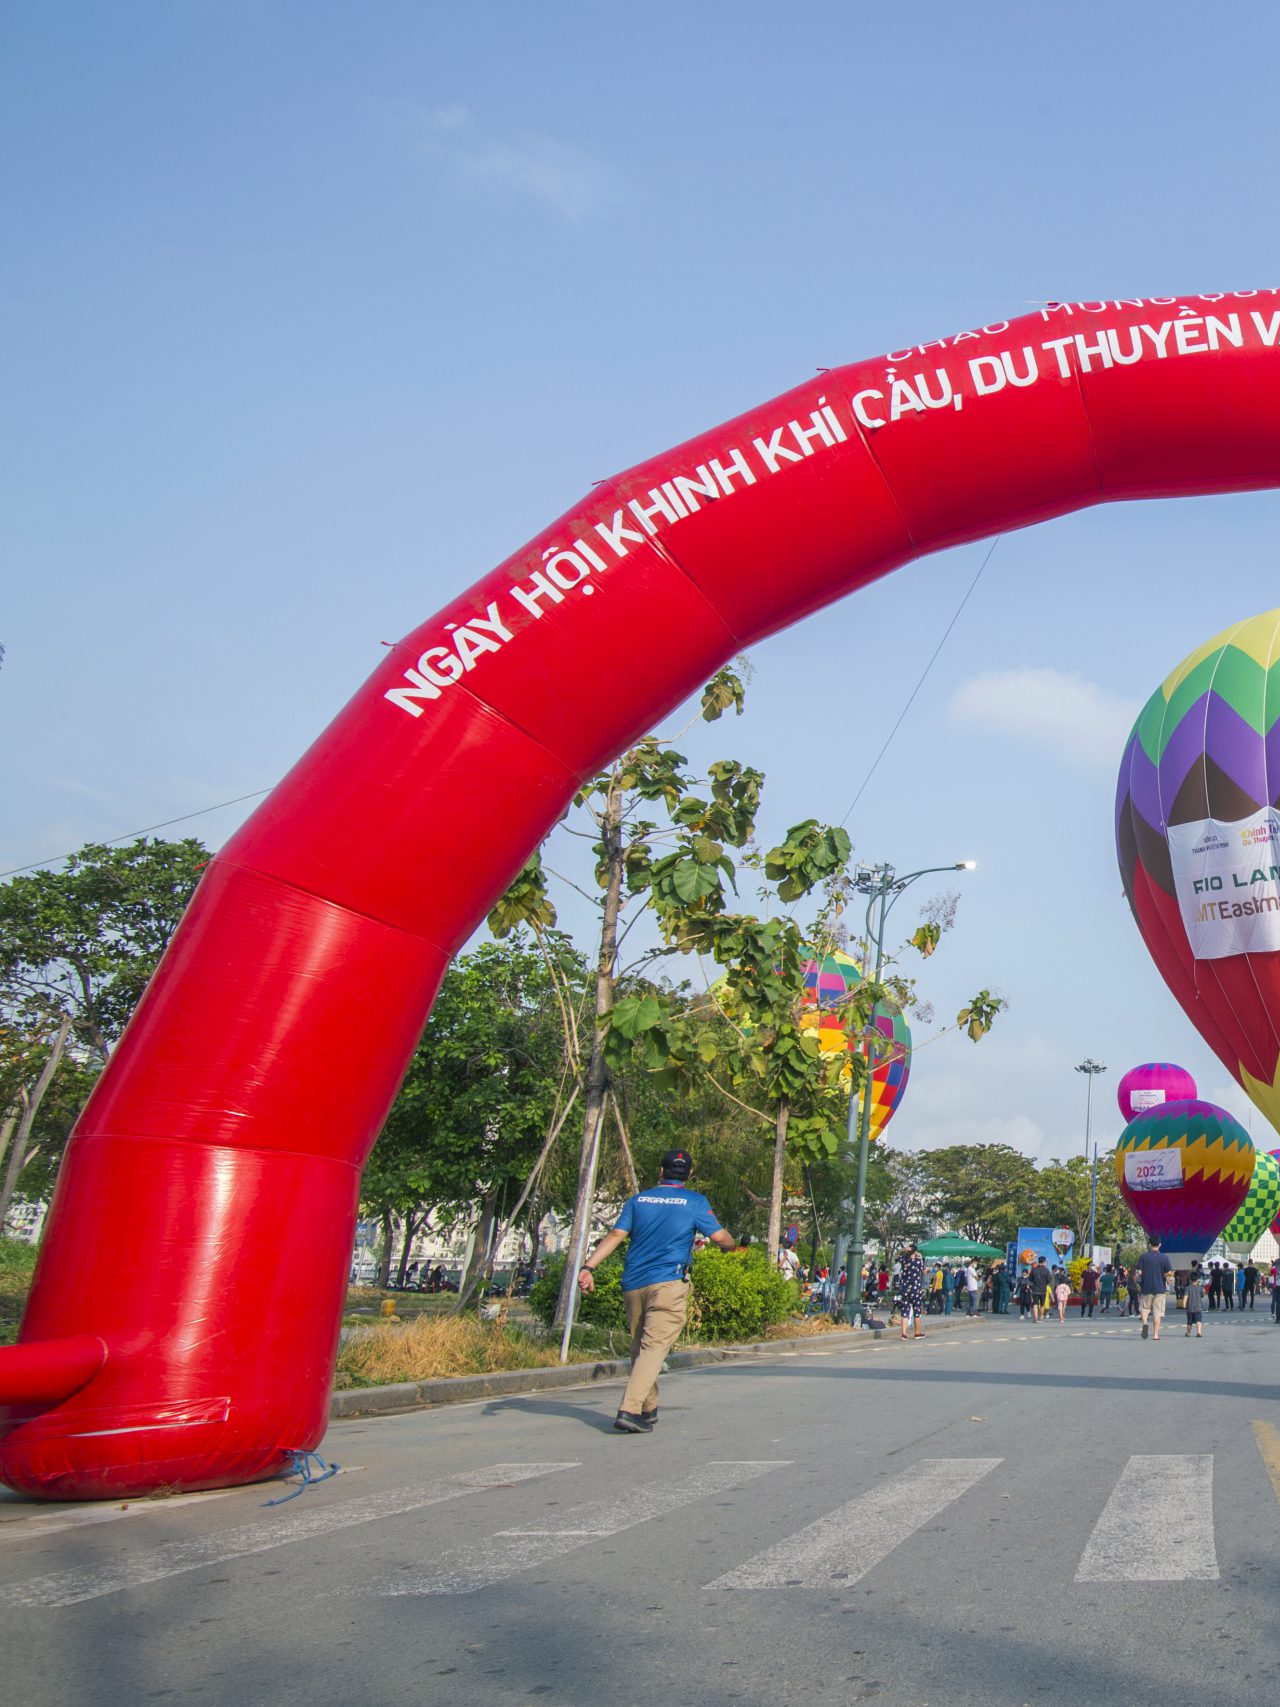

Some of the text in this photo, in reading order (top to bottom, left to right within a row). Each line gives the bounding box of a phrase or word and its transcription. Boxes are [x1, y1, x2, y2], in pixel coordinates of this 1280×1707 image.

[385, 601, 514, 718] NGÀY
[509, 539, 608, 597] HỘI
[594, 448, 757, 559] KHINH
[753, 396, 847, 474] KHÍ
[968, 344, 1040, 397] DU
[1042, 306, 1243, 379] THUYỀN
[1192, 876, 1223, 894] FIO
[1136, 1164, 1164, 1178] 2022
[637, 1196, 688, 1206] ORGANIZER
